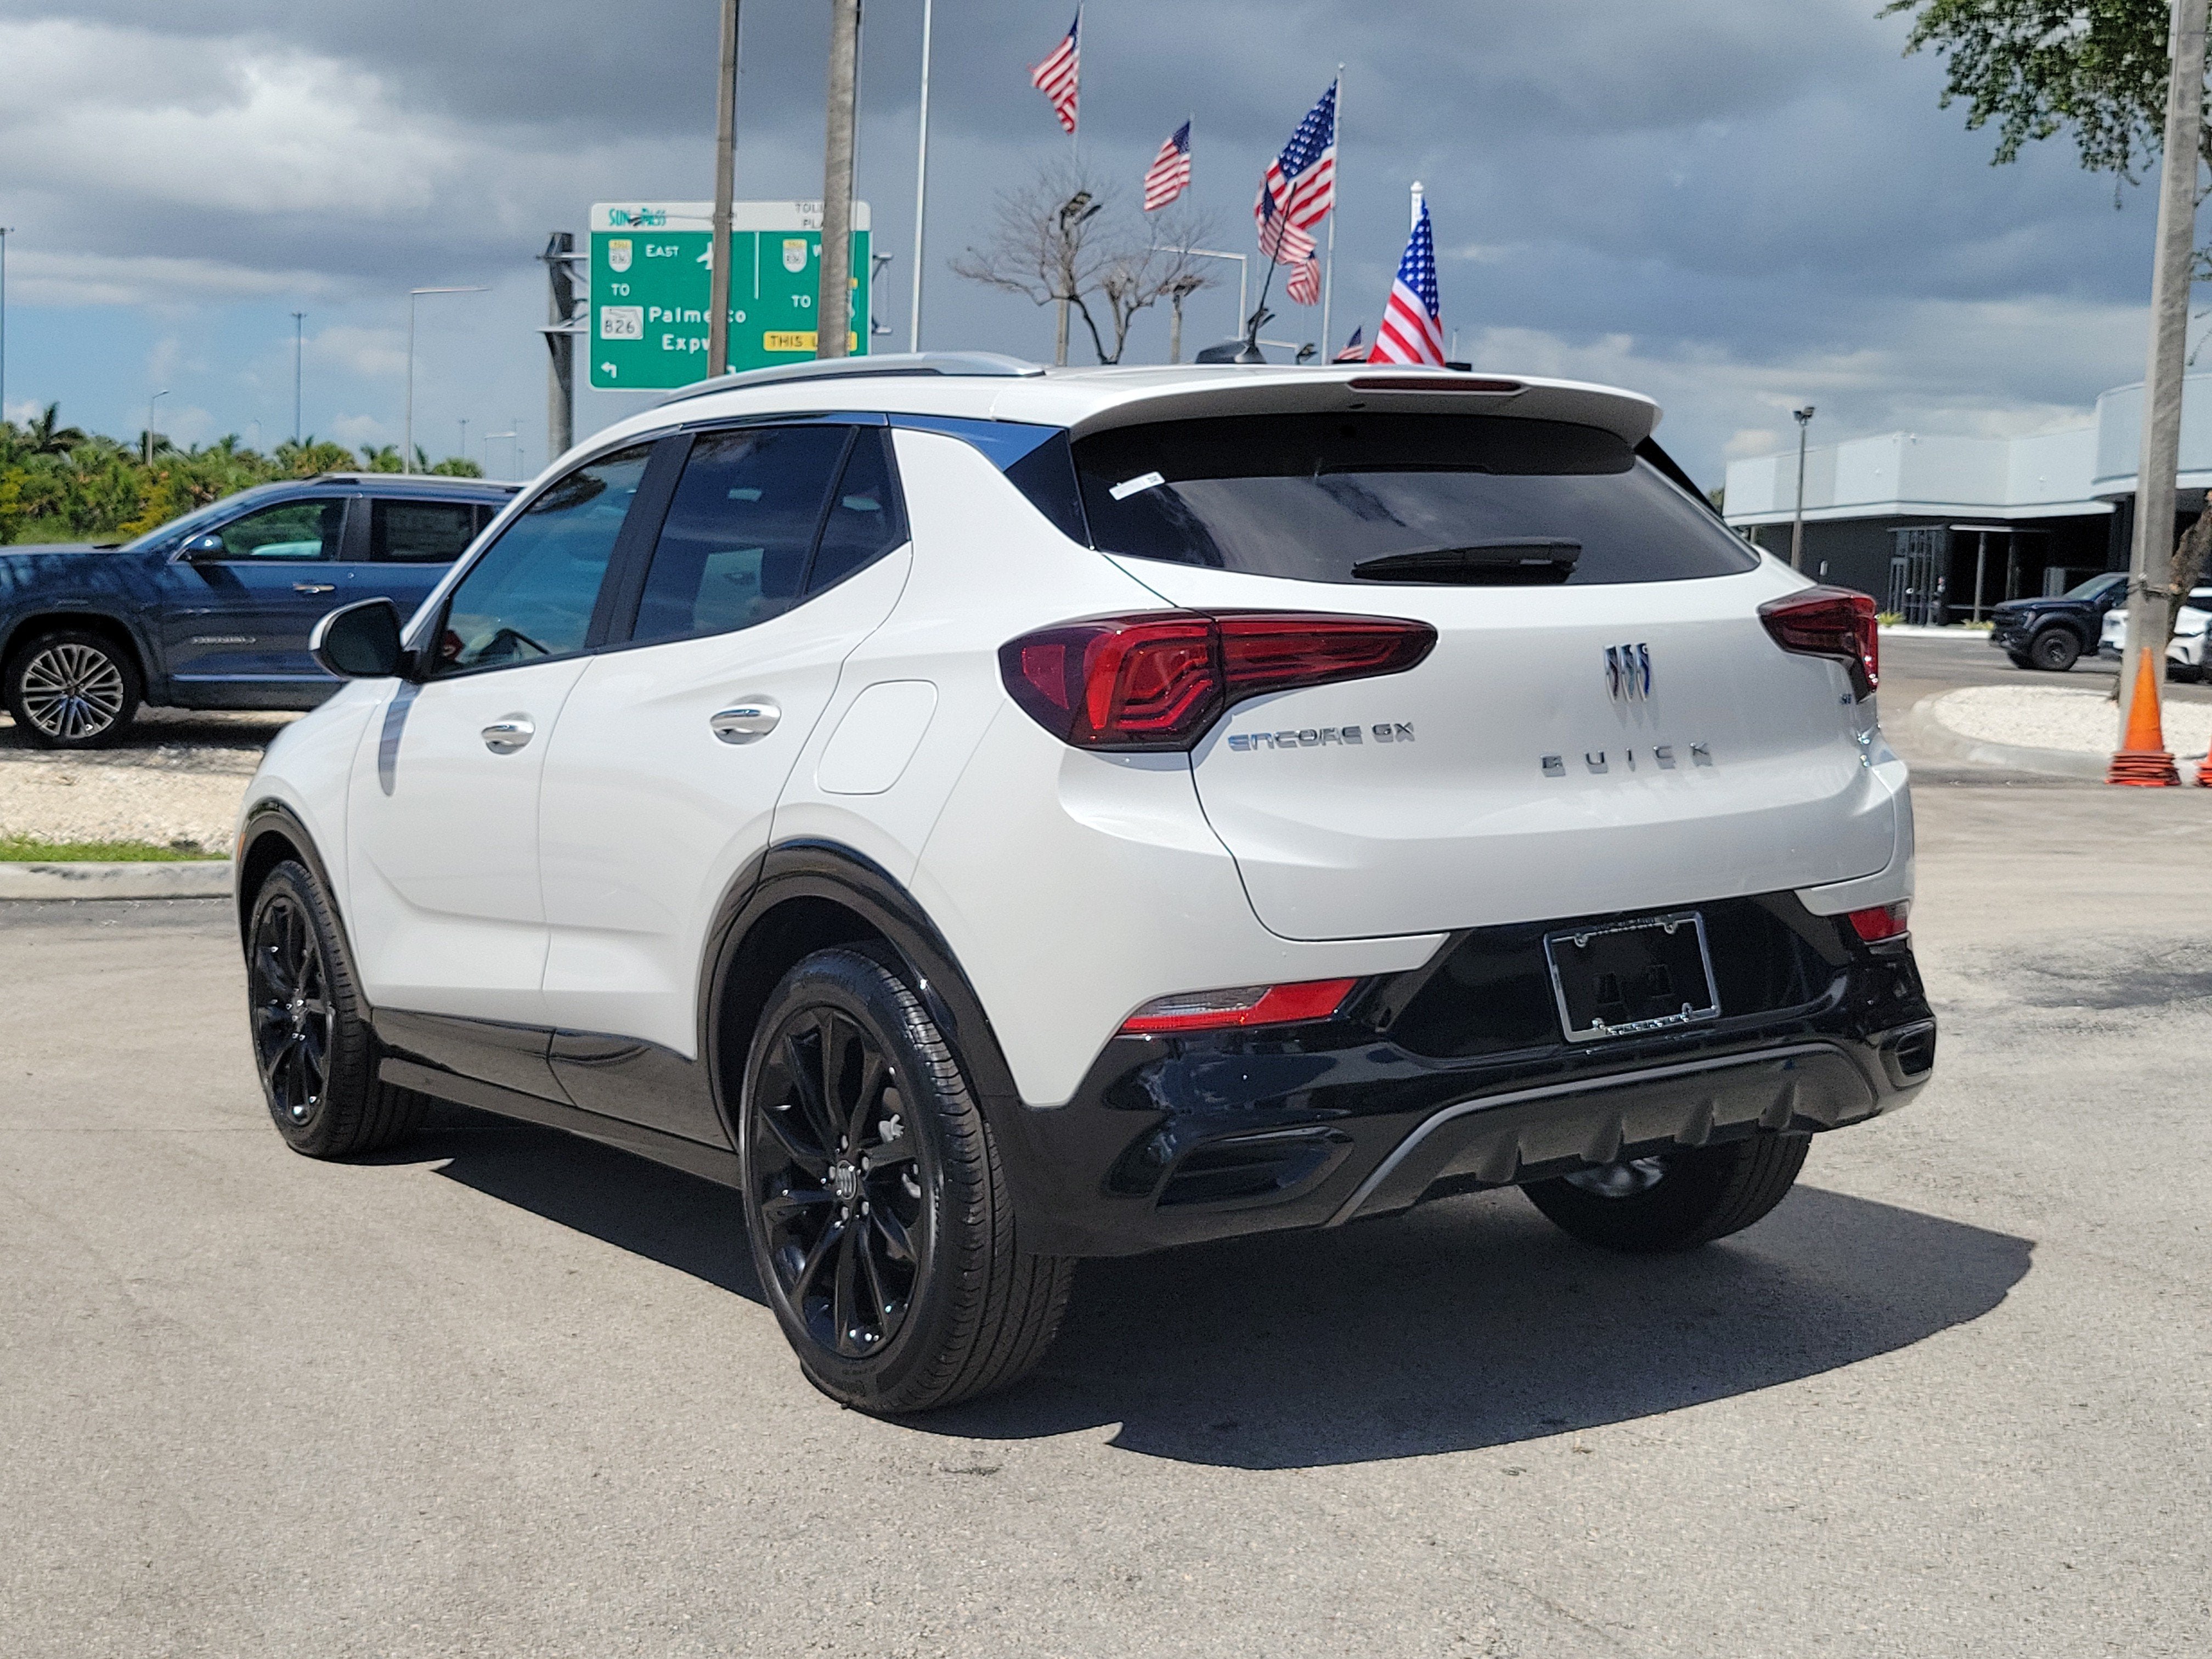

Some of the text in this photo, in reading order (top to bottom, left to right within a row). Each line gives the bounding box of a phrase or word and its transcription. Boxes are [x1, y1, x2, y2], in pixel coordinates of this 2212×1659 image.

[646, 244, 679, 257] EAST
[611, 283, 630, 296] TO
[791, 294, 811, 308] TO
[604, 320, 635, 334] 826
[770, 335, 803, 347] THIS
[1228, 722, 1415, 751] ENCORE GX
[1541, 742, 1711, 774] BUICK
